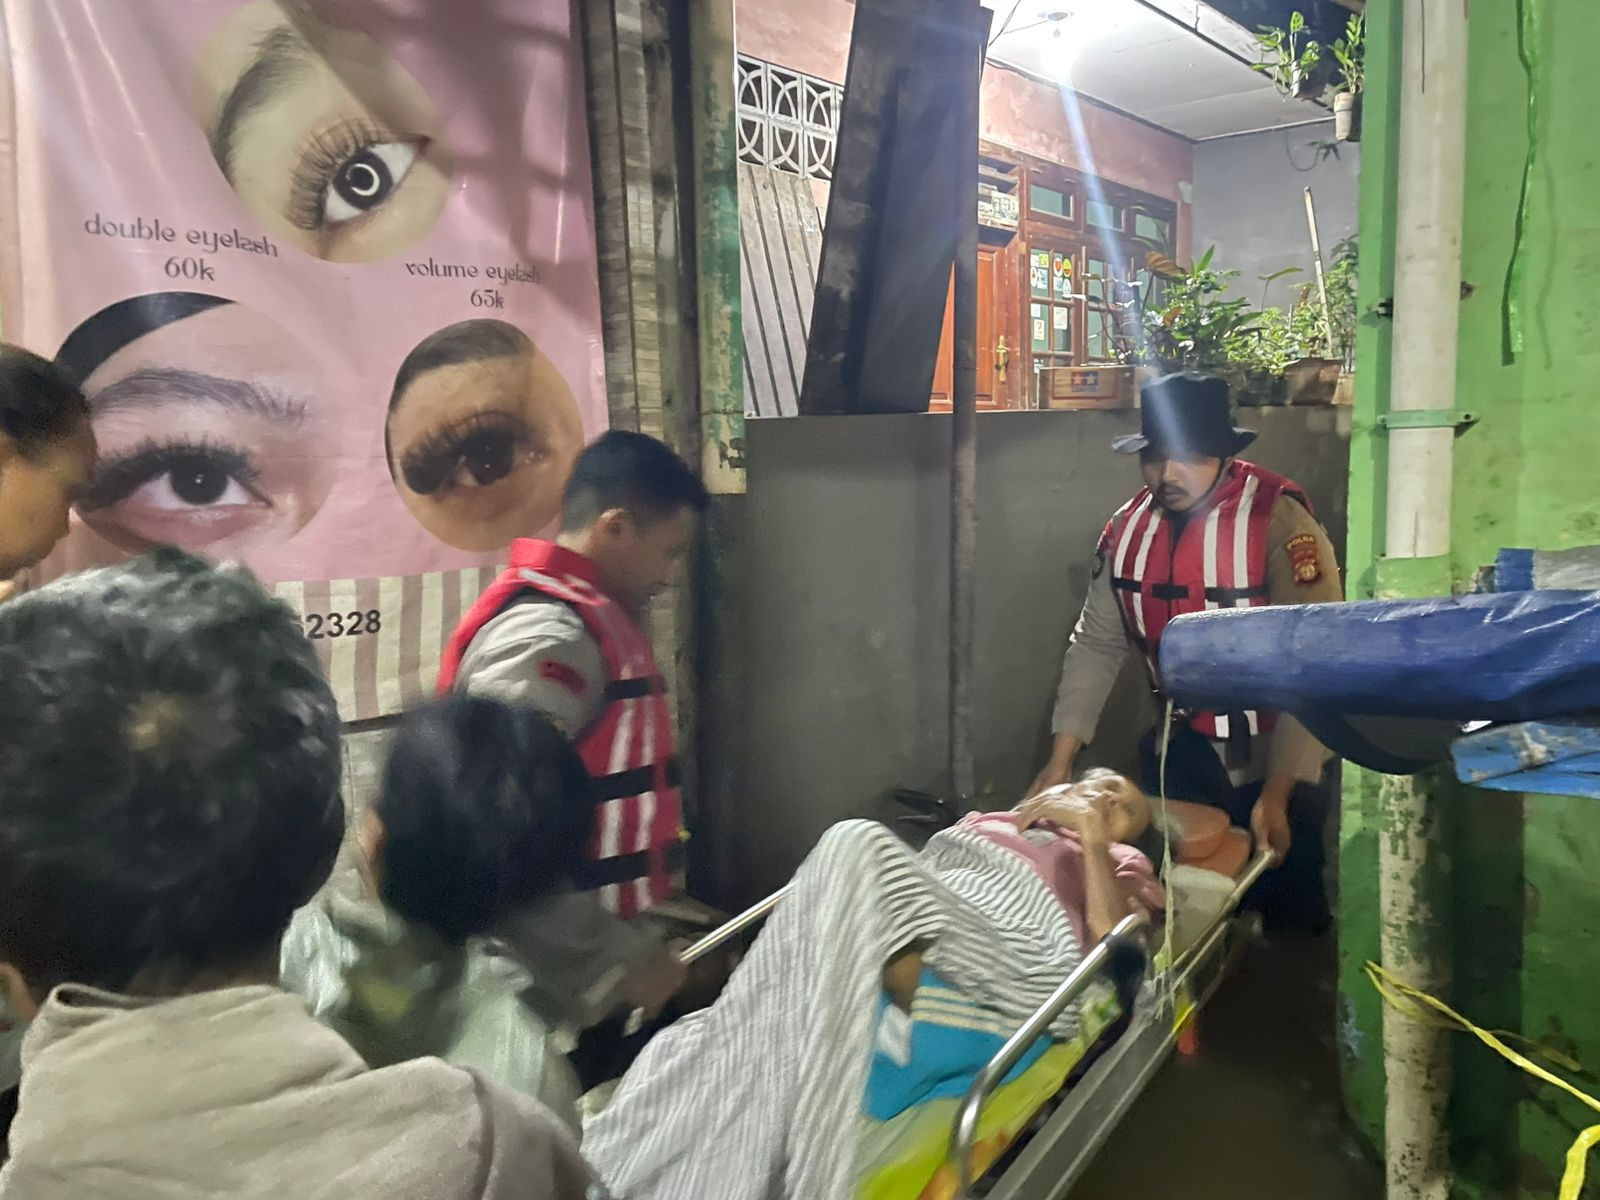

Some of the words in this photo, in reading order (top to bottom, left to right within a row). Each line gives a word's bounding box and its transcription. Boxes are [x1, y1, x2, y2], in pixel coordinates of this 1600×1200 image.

[84, 212, 176, 242] double
[185, 228, 279, 257] eyelash
[164, 256, 215, 281] 60k
[405, 257, 478, 278] volume
[485, 262, 540, 286] eyelash
[470, 289, 504, 309] 65k
